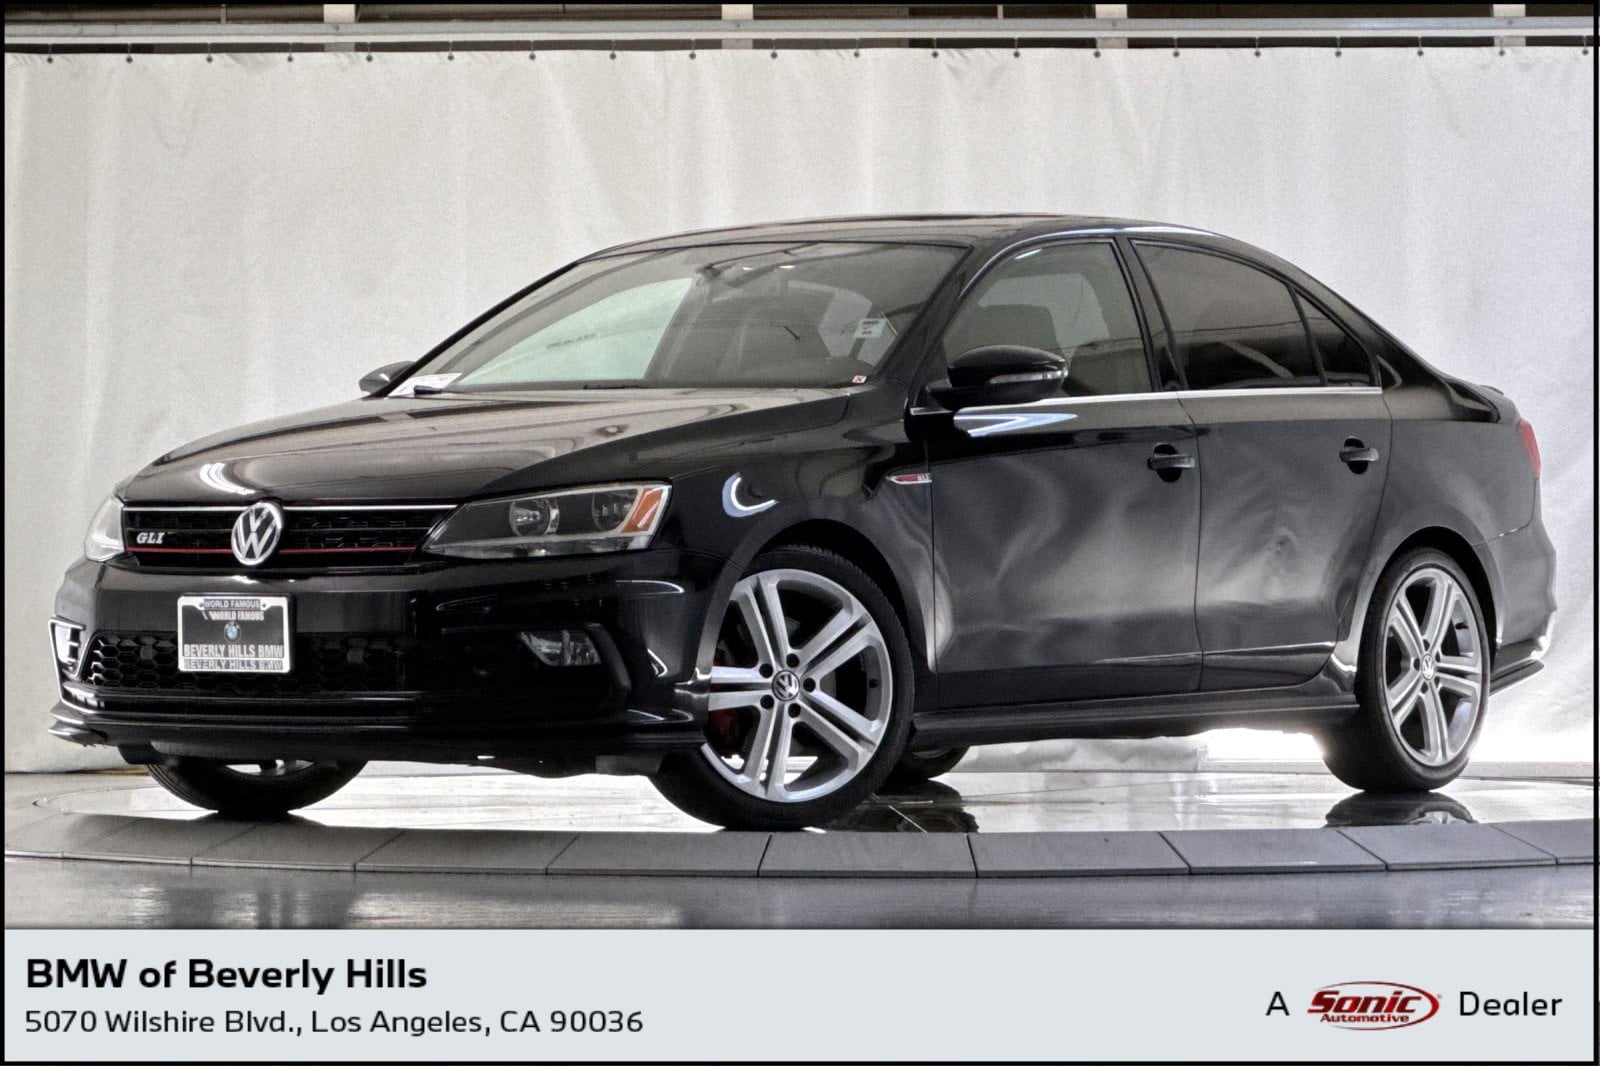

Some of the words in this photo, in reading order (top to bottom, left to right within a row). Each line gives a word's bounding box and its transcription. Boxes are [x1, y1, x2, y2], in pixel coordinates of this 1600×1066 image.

[136, 532, 165, 545] GLI
[204, 600, 229, 609] WORLD
[231, 600, 261, 609] FAMOUS
[209, 610, 237, 621] WORLD
[237, 610, 265, 621] FAMOUS
[183, 644, 227, 658] BEVERLY
[228, 644, 256, 658] HILLS
[257, 644, 284, 658] BMW
[184, 659, 227, 670] BEVERLY
[228, 659, 257, 670] HILLS
[259, 659, 284, 670] BMW
